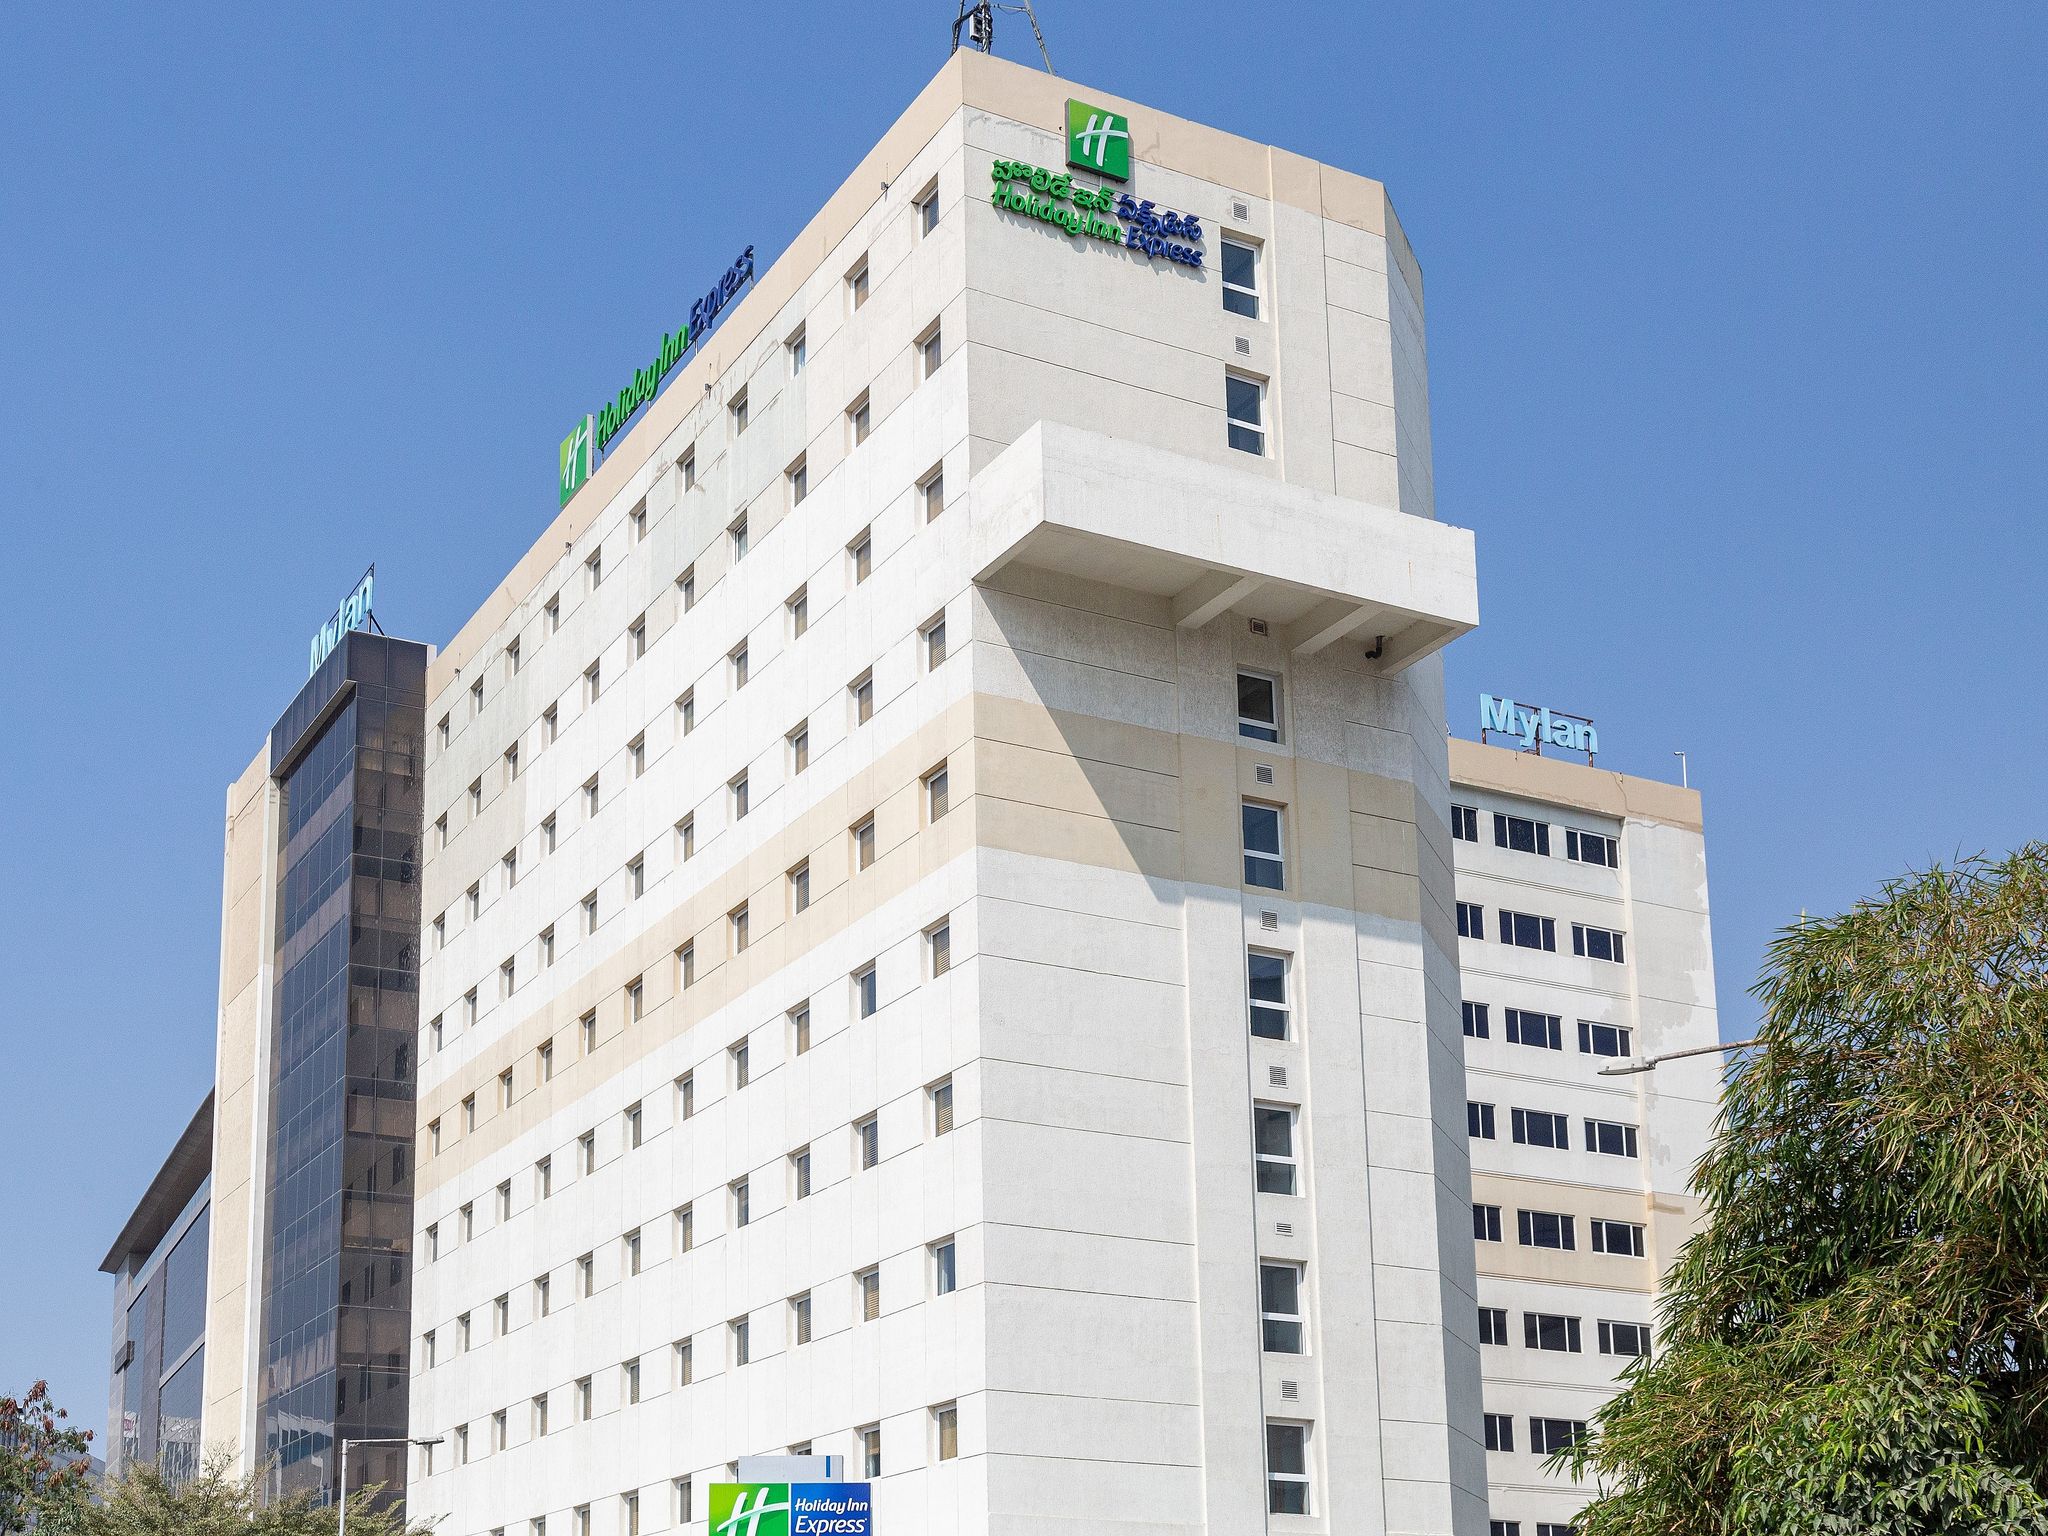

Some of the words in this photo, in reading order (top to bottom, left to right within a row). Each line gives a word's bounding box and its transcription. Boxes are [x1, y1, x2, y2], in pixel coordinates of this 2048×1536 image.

[991, 180, 1083, 237] Holiday
[1085, 209, 1122, 245] Inn
[1125, 225, 1203, 268] Express
[595, 357, 661, 450] Holiday
[660, 324, 690, 376] Inn
[688, 244, 755, 342] Express
[1480, 693, 1599, 755] Mylan
[794, 1497, 847, 1515] Holiday
[847, 1498, 869, 1512] Inn
[794, 1515, 866, 1536] Express
